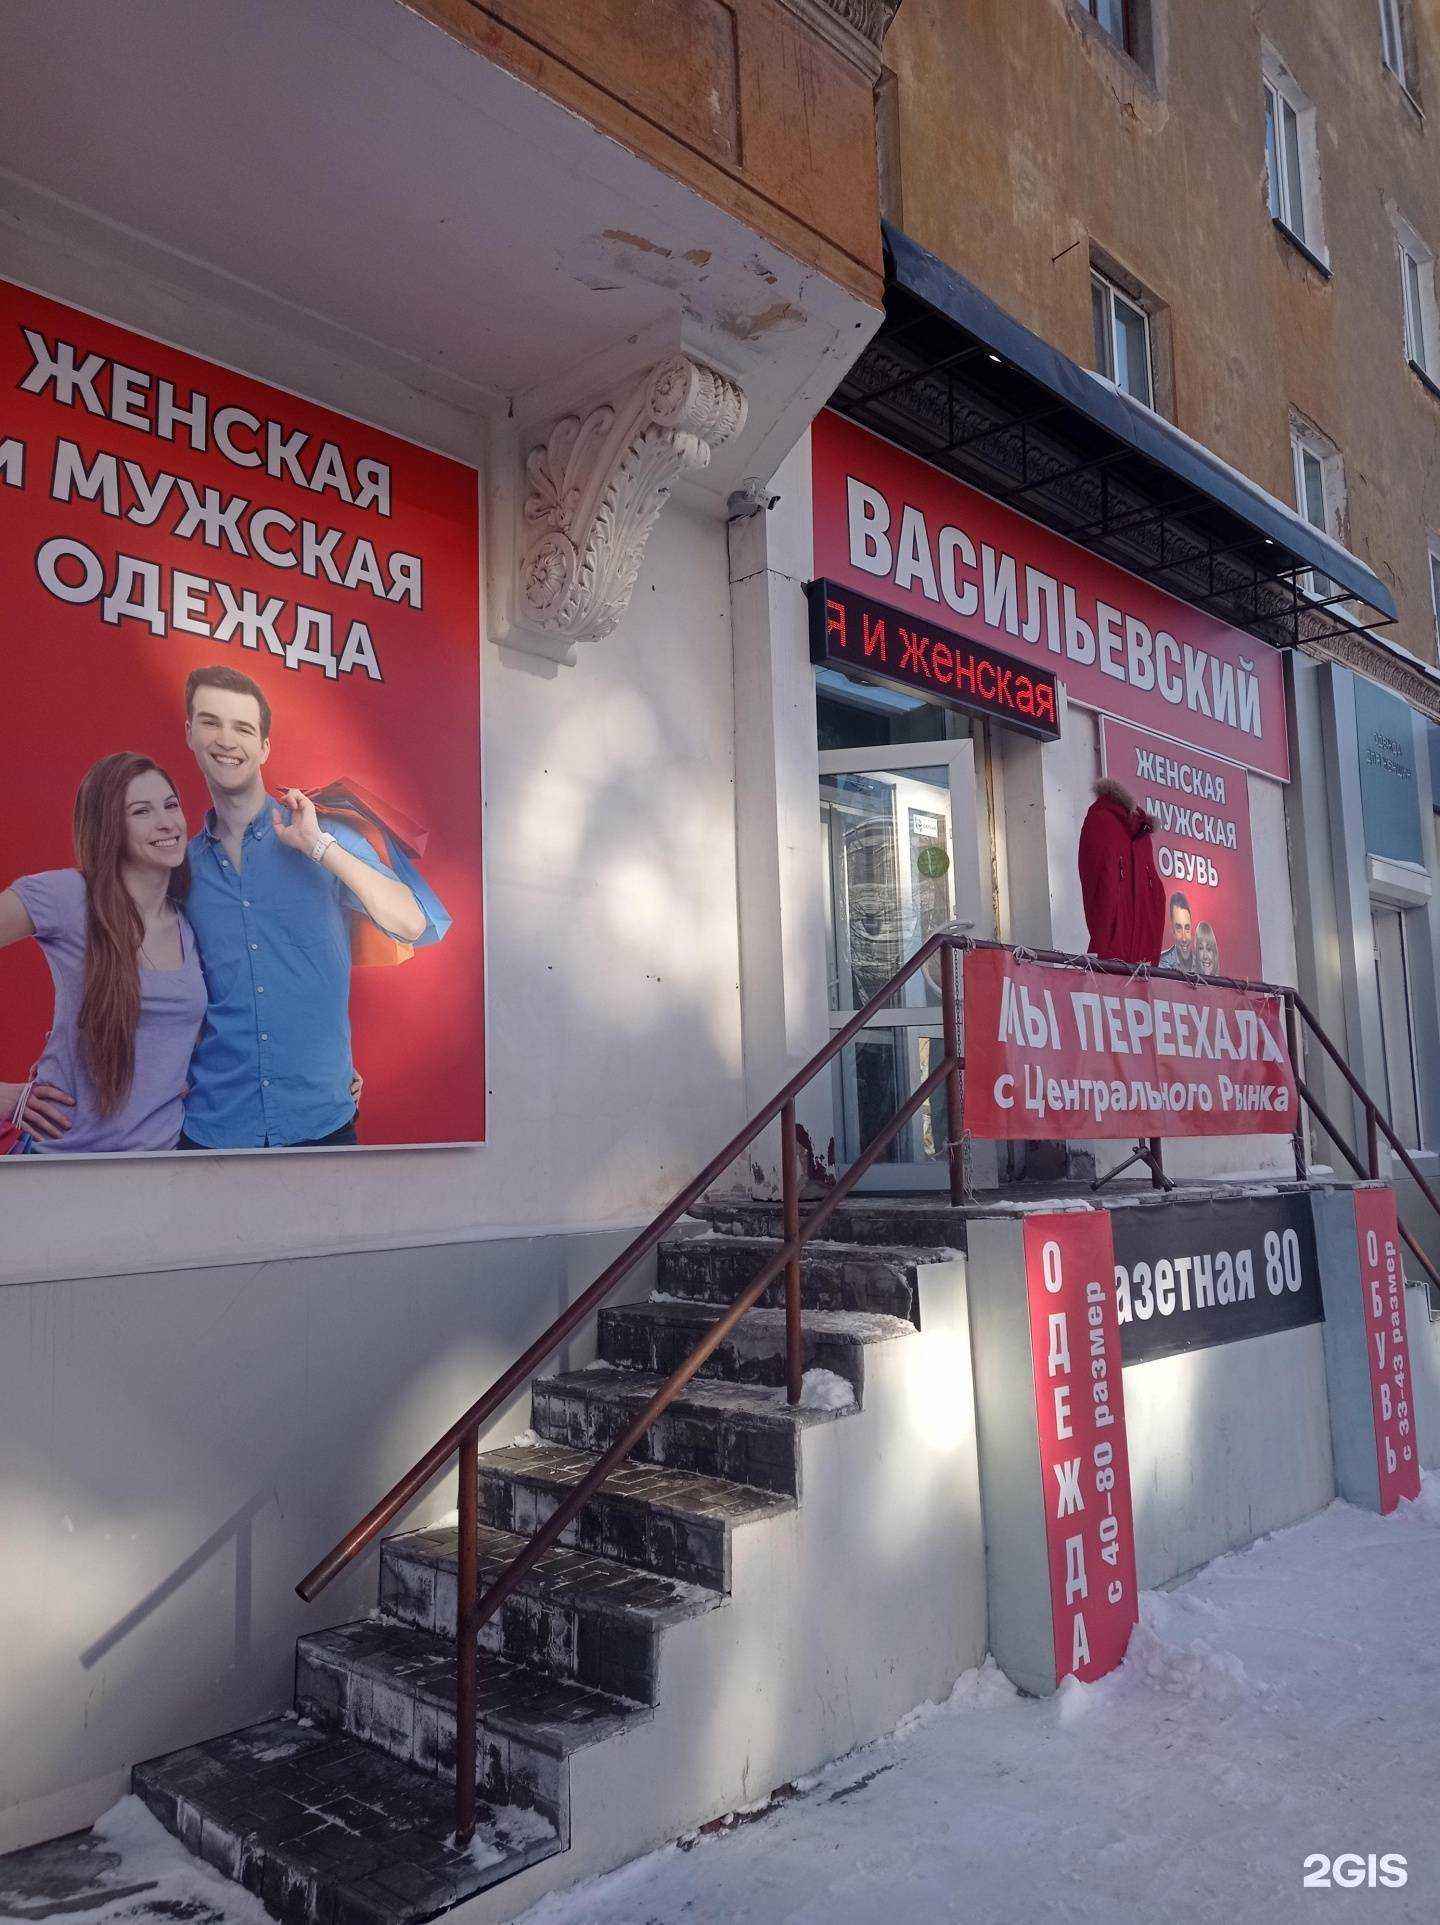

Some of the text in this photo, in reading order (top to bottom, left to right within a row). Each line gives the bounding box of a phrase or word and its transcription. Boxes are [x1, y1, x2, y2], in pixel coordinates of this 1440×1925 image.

[19, 328, 391, 516] ЖЕНСКАЯ
[52, 439, 423, 609] МУЖСКАЯ
[36, 537, 382, 681] ОДЕЖДА
[846, 475, 1263, 738] ВАСИЛЬЕВСКИЙ
[898, 628, 1055, 722] женская
[1136, 748, 1226, 805] ЖЕНСКАЯ
[1146, 797, 1237, 850] МУЖСКАЯ
[1158, 846, 1219, 887] ОБУВЬ
[1024, 1065, 1213, 1122] Центрального
[1218, 1074, 1289, 1111] Рынка
[1114, 1228, 1302, 1326] азетная 80
[1385, 1241, 1404, 1344] размер
[1087, 1281, 1114, 1428] размер
[1367, 1230, 1396, 1474] ОБУВЬ
[1042, 1240, 1091, 1671] ОДЕЖДА
